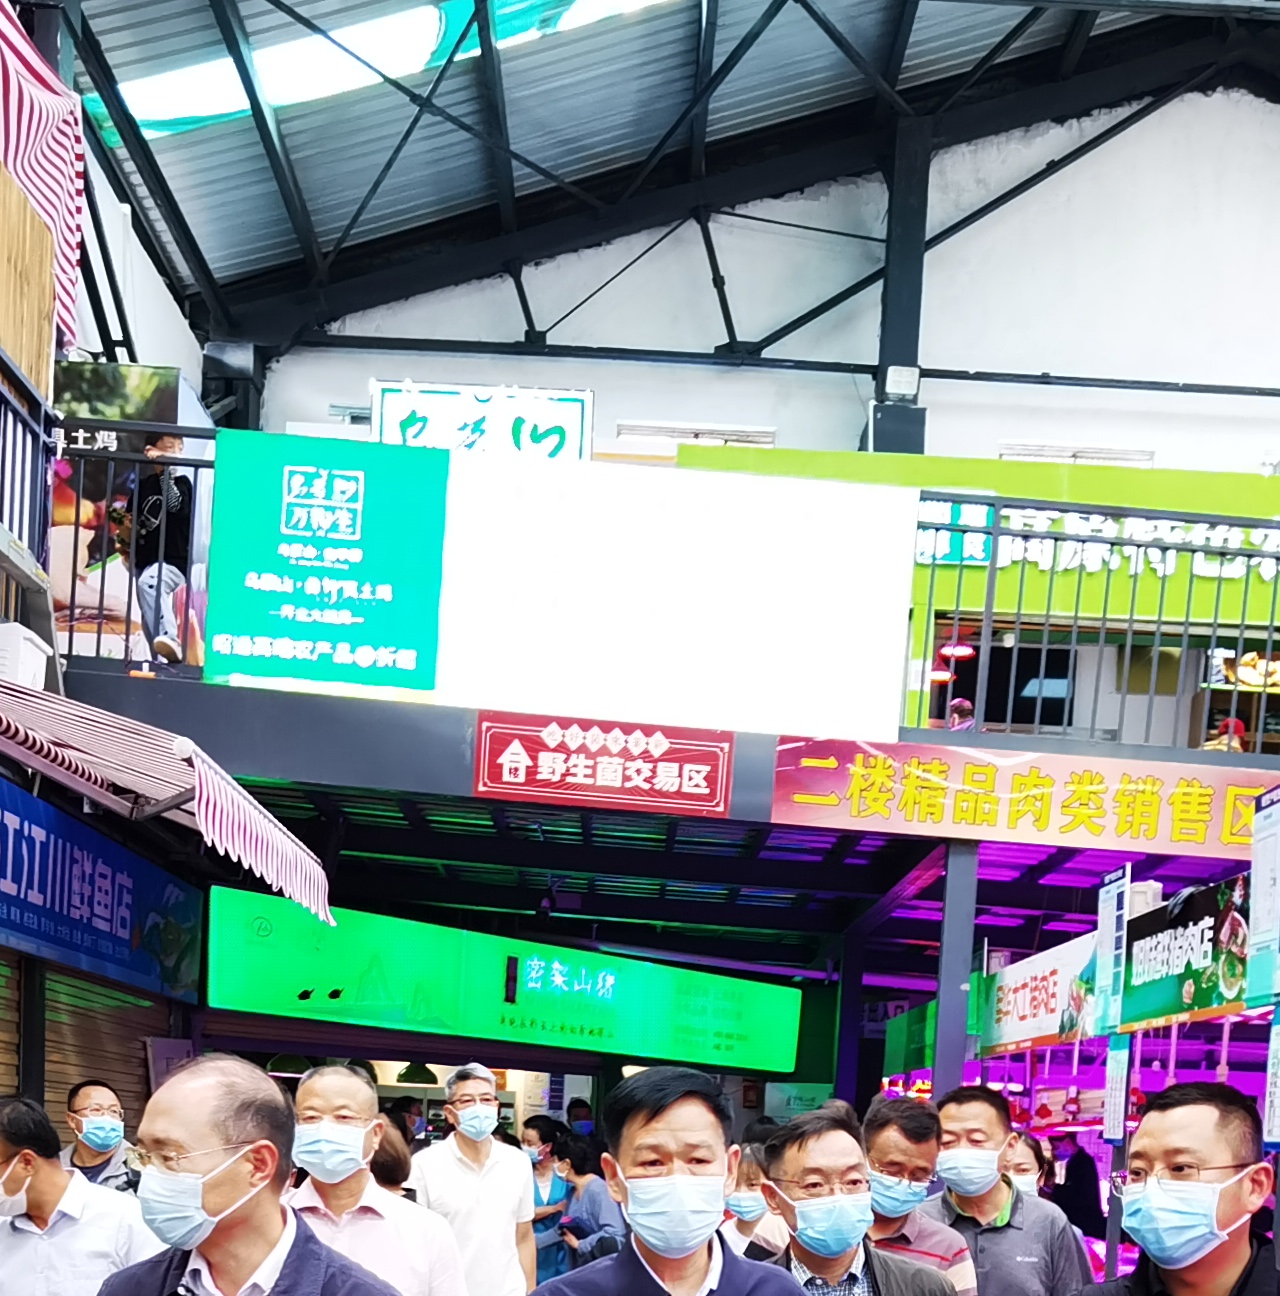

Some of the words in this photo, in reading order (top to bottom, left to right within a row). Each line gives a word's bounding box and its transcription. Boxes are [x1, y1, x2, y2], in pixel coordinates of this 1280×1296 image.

[536, 750, 712, 795] 野生菌交易区
[792, 752, 1267, 847] 二楼精品肉类销售区
